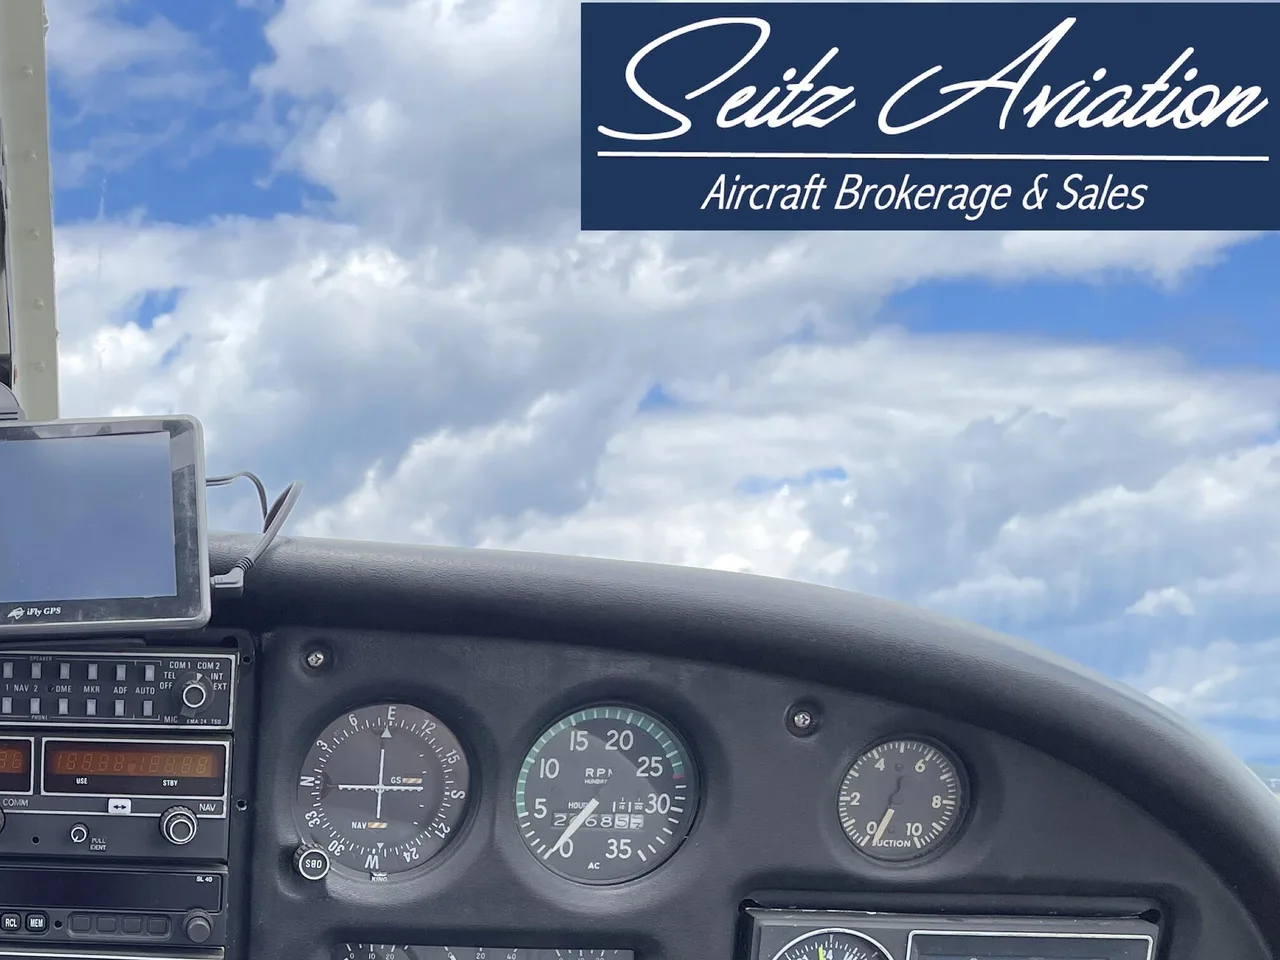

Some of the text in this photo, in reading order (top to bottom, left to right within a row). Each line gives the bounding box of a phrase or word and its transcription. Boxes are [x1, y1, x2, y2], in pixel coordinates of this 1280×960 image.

[26, 608, 42, 617] iFly
[170, 661, 186, 669] COM
[197, 662, 214, 670] COM
[14, 684, 29, 692] NAV
[55, 685, 72, 693] DME
[135, 687, 155, 695] AUTO
[570, 730, 589, 751] 15
[604, 730, 634, 750] 20
[539, 758, 560, 779] 10
[635, 756, 663, 777] 25
[2, 798, 28, 806] COMM
[645, 793, 670, 814] 30
[199, 804, 216, 812] NAV
[533, 798, 547, 819] 5
[905, 822, 922, 836] 10
[872, 839, 911, 848] UCTION
[605, 839, 632, 859] 35
[5, 918, 17, 927] RCL
[30, 918, 43, 927] MEM
